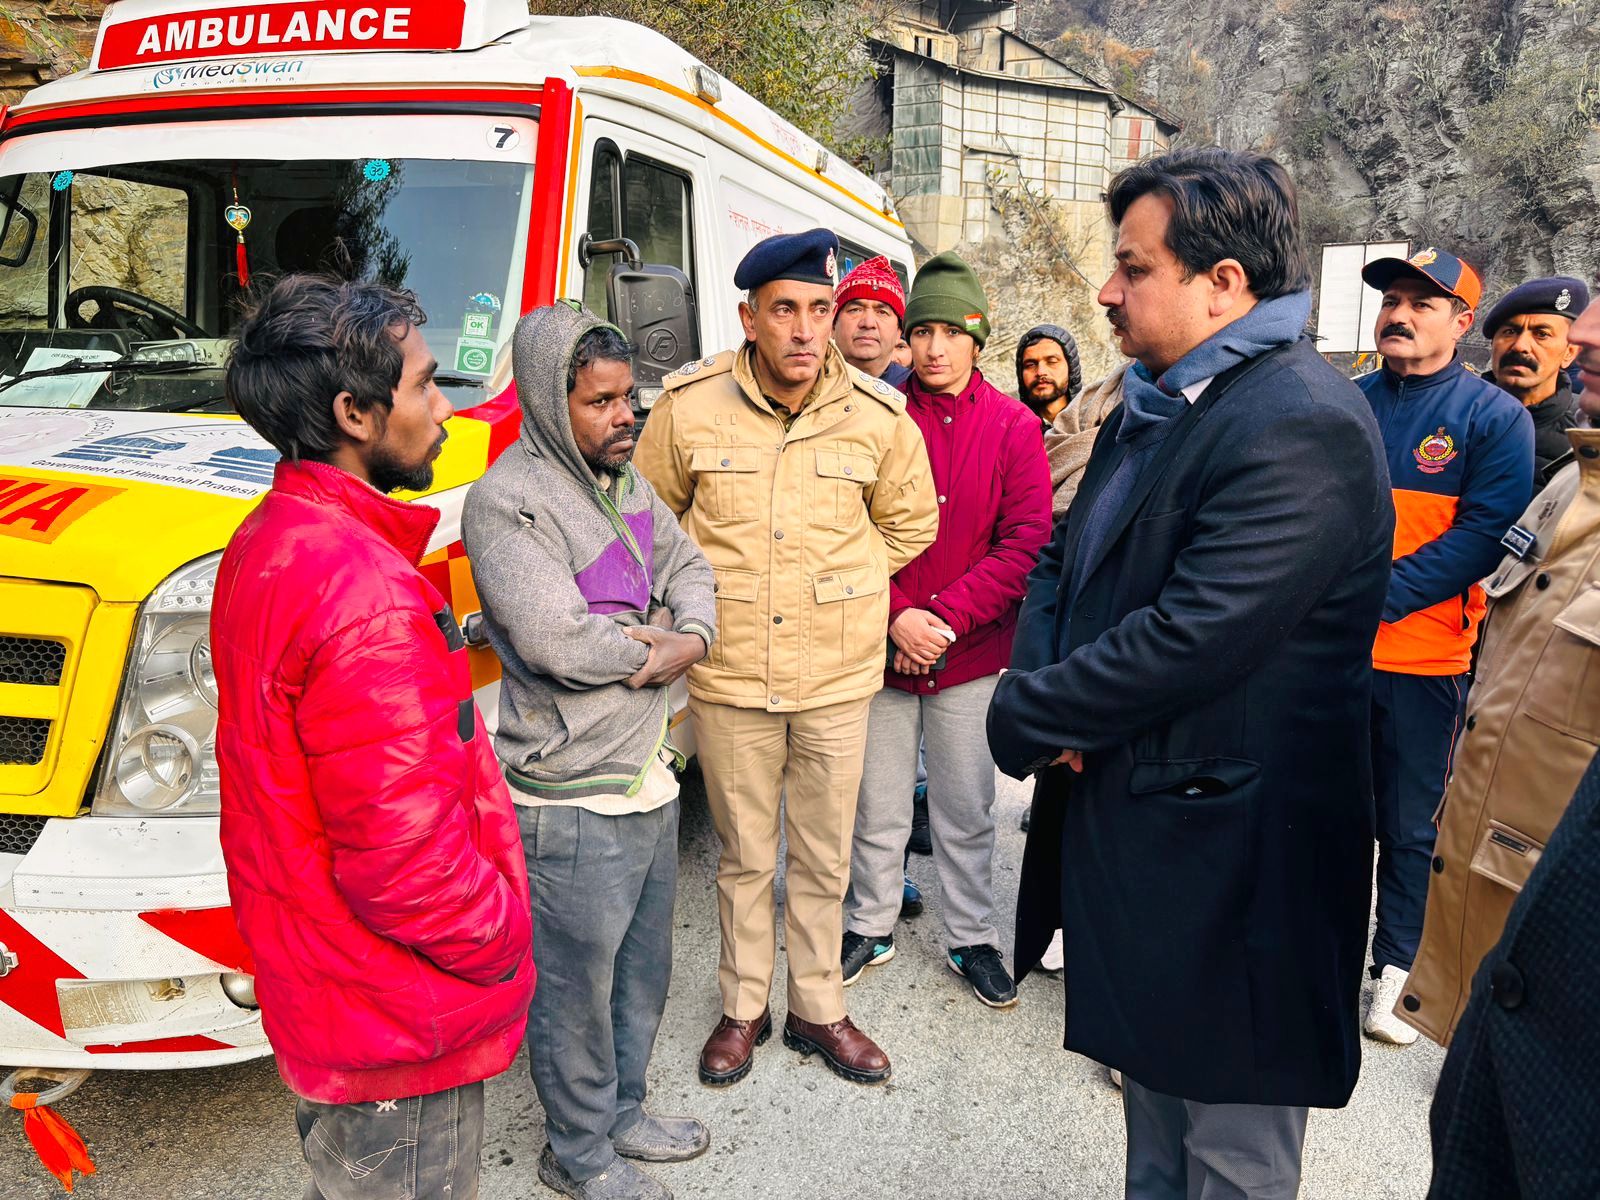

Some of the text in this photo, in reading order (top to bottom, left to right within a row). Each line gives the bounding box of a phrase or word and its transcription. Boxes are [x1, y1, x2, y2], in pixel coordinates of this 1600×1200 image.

[136, 7, 411, 56] AMBULANCE
[183, 60, 303, 80] MedSwan
[494, 127, 514, 148] 7
[470, 321, 484, 329] OK
[31, 459, 114, 474] Government
[130, 470, 199, 485] Himachal
[199, 480, 260, 496] Pradesh
